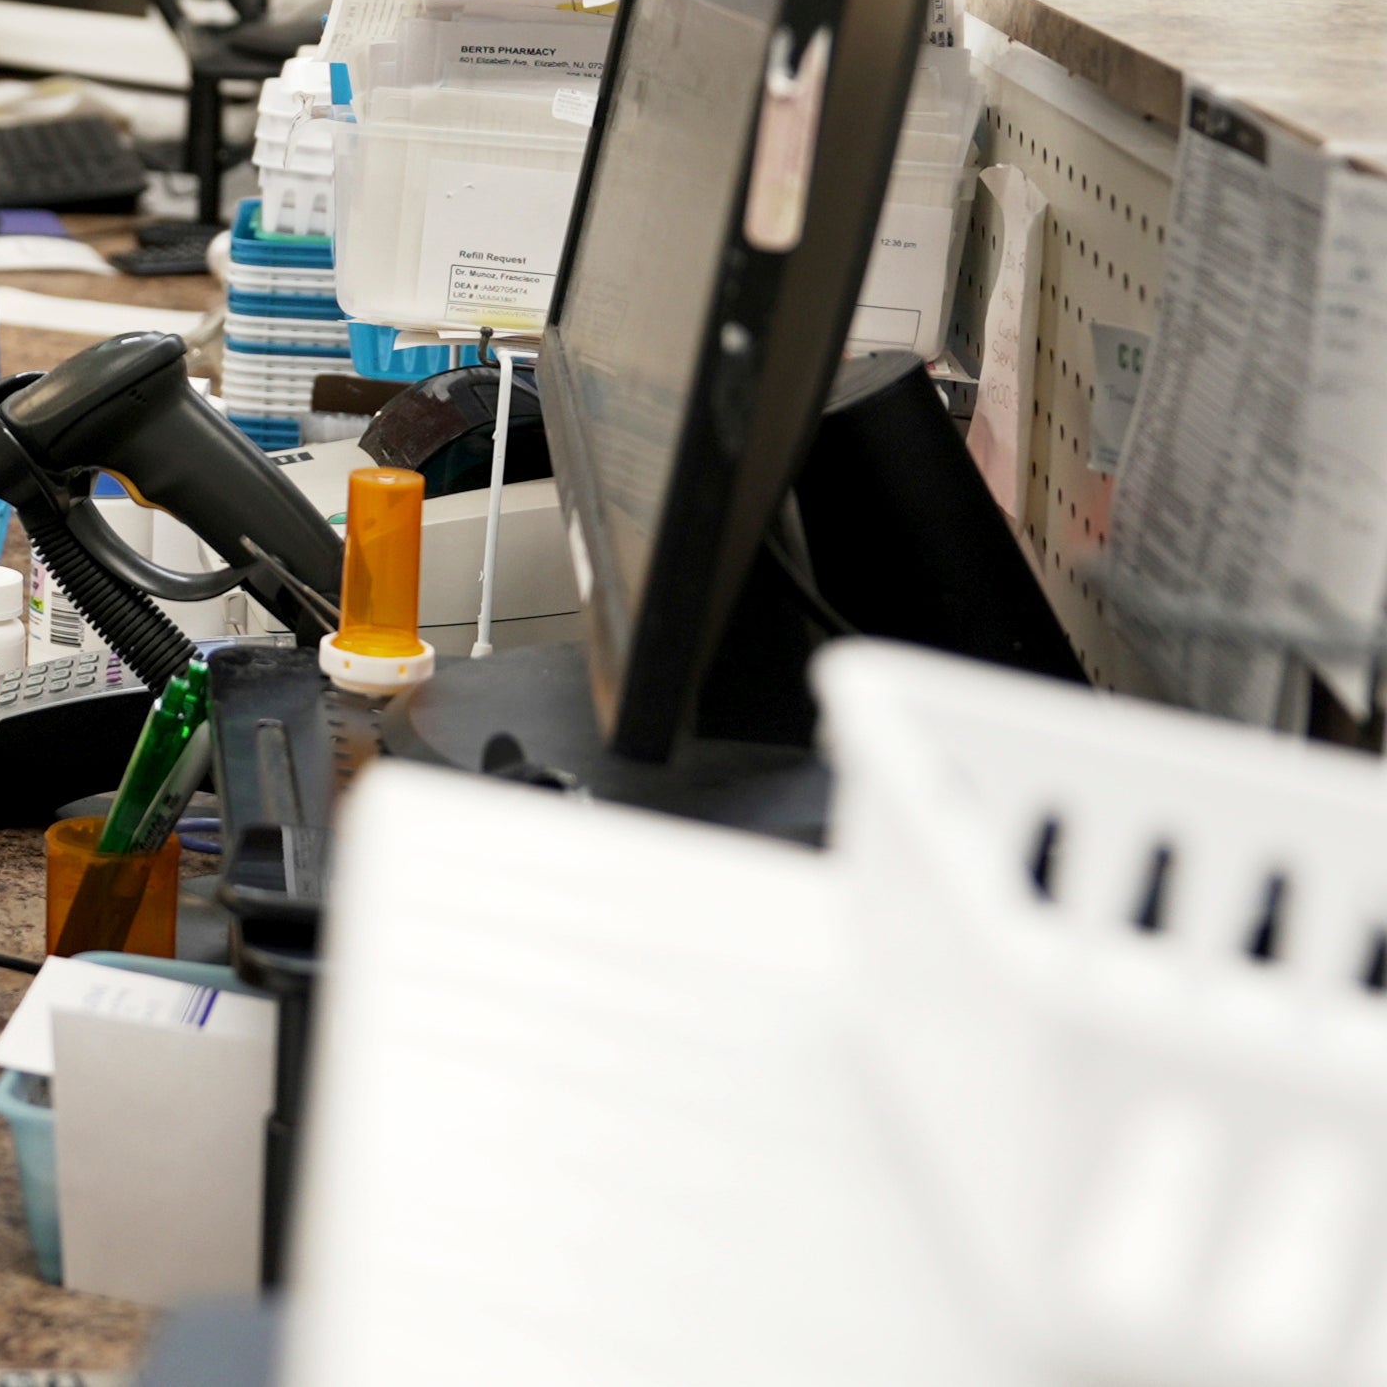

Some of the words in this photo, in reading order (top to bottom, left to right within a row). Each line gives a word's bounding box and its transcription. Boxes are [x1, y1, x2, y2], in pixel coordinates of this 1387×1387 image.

[460, 45, 495, 54] BERTS
[498, 46, 557, 56] PHARMACY
[476, 57, 510, 65] Elizabeth
[903, 241, 917, 249] pm
[459, 250, 484, 260] Refill
[486, 252, 527, 265] Request
[455, 268, 467, 276] Dr.
[500, 272, 540, 284] Francisco
[454, 281, 472, 290] DEA
